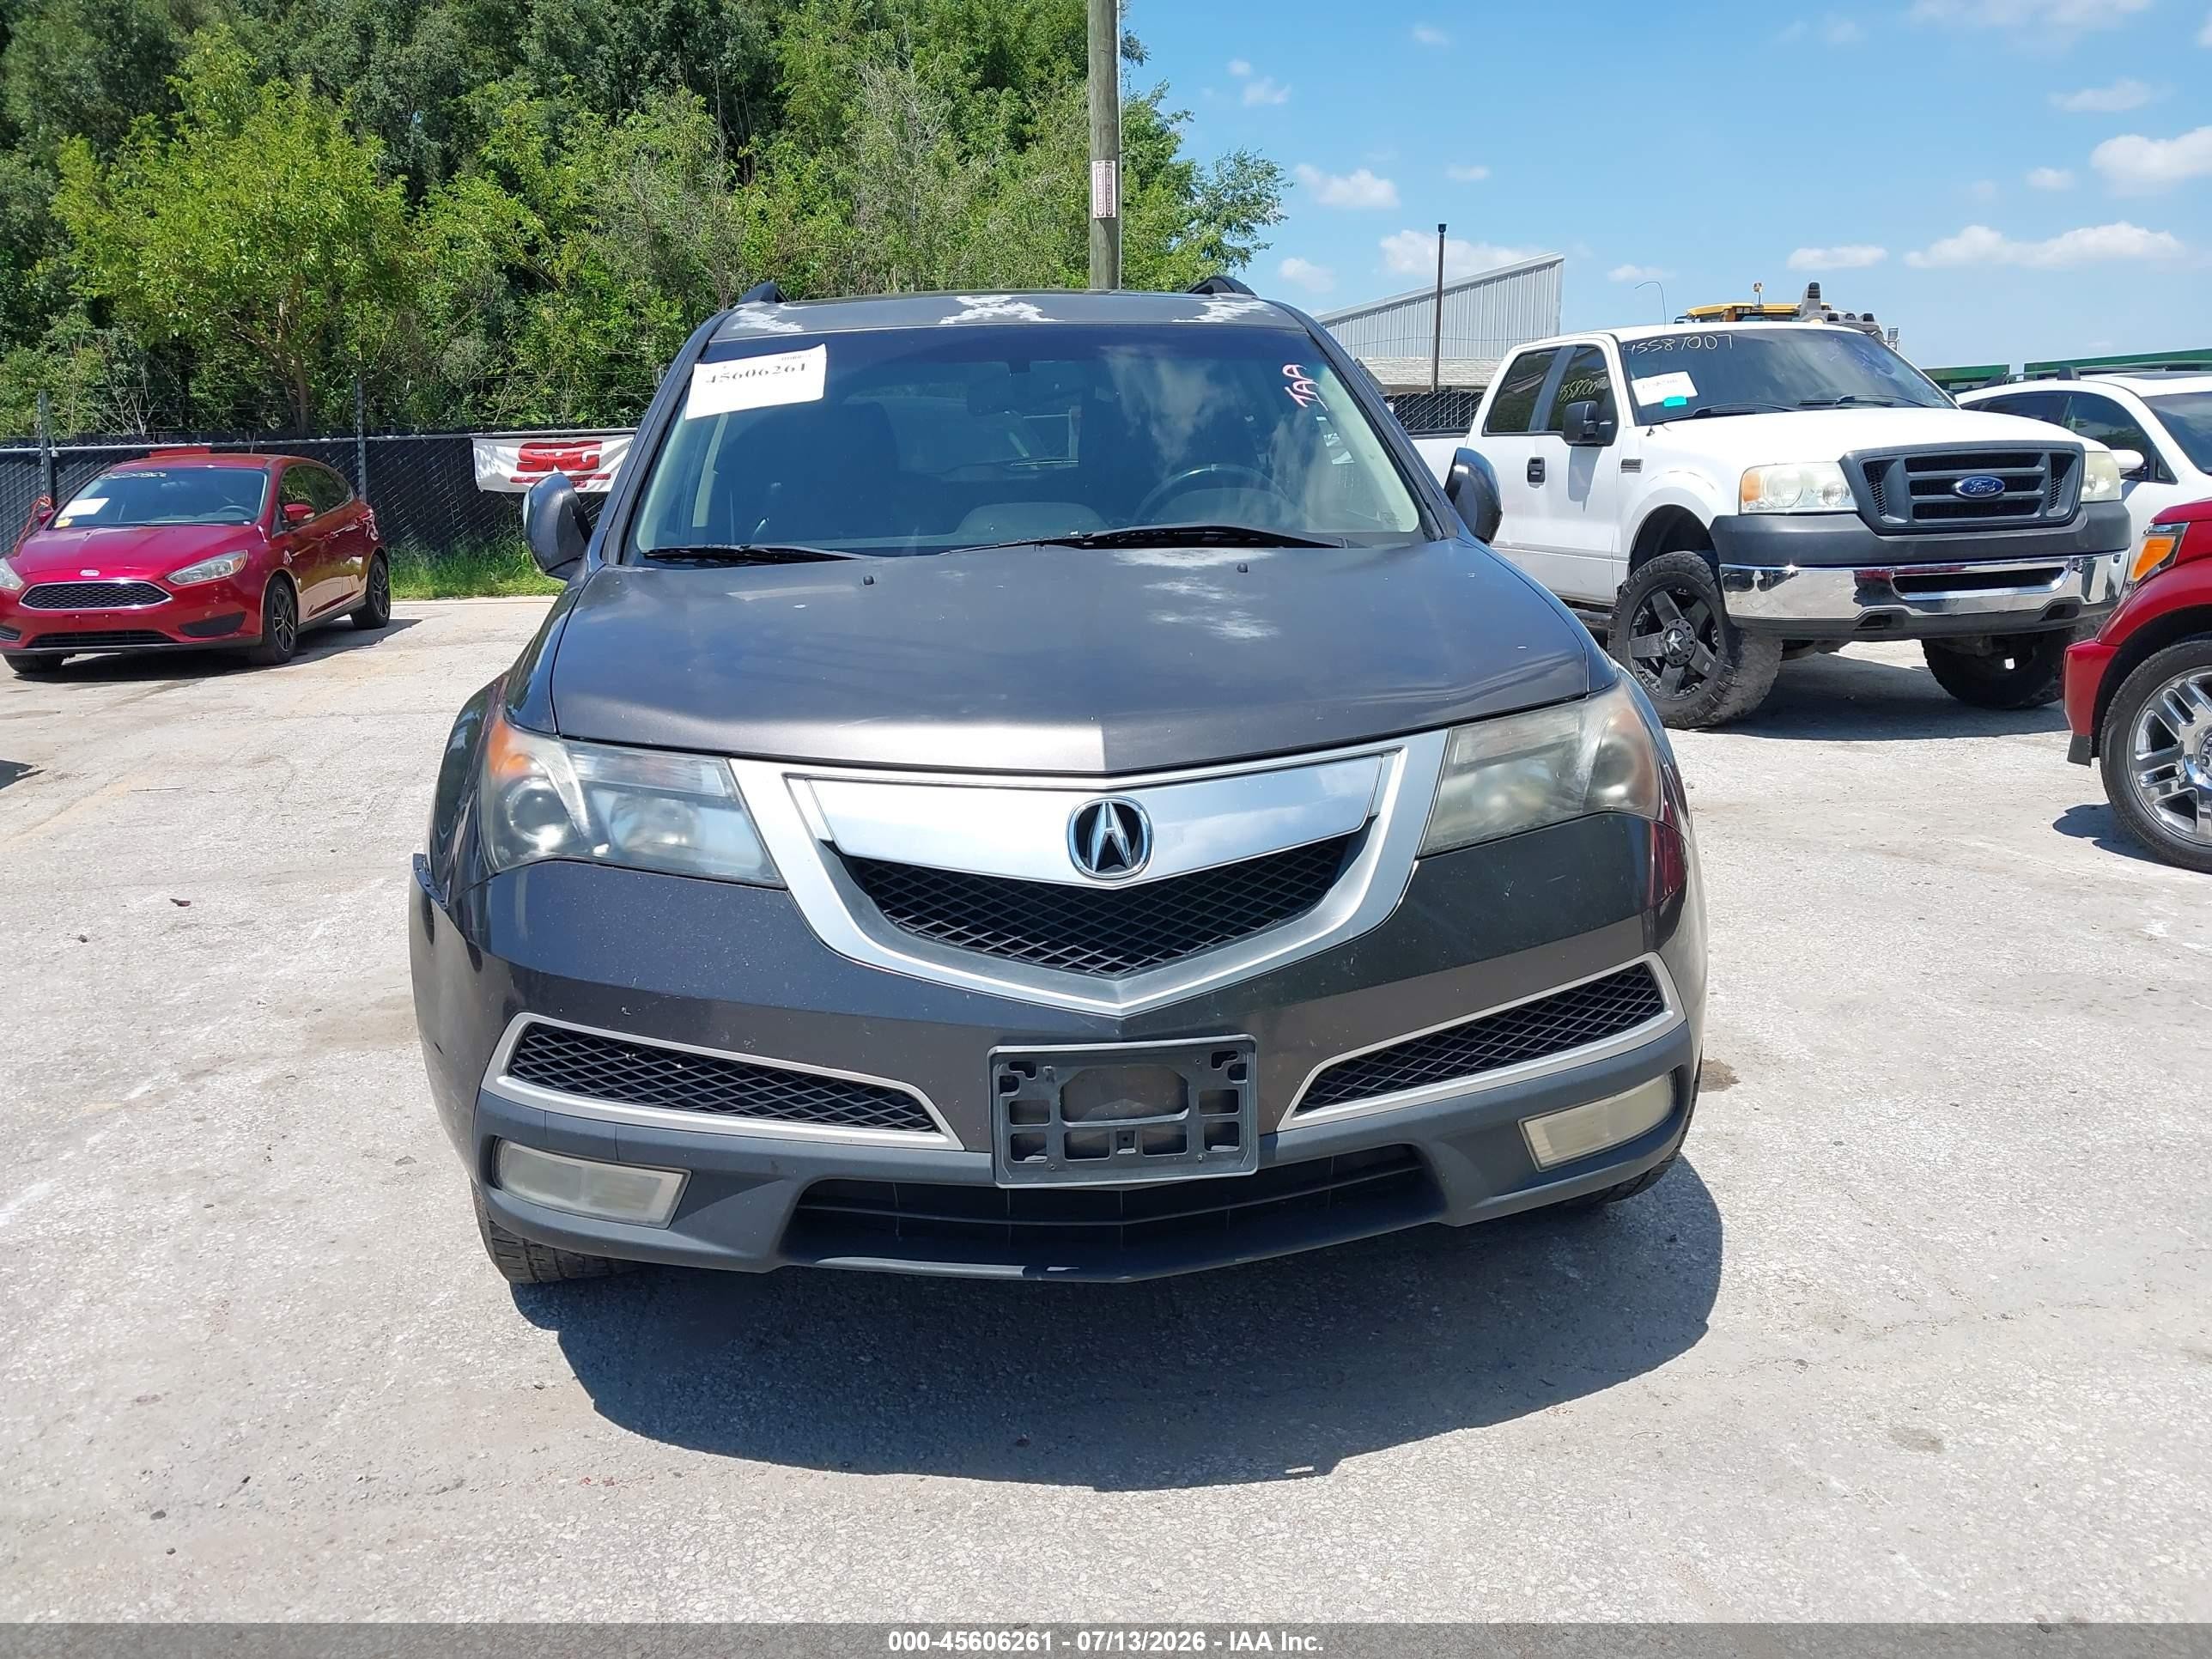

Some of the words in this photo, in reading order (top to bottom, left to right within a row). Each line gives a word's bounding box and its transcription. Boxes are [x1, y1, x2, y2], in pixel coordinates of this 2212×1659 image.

[1622, 333, 1733, 356] 45587007
[516, 440, 604, 473] SRG
[1969, 479, 1996, 493] Ford
